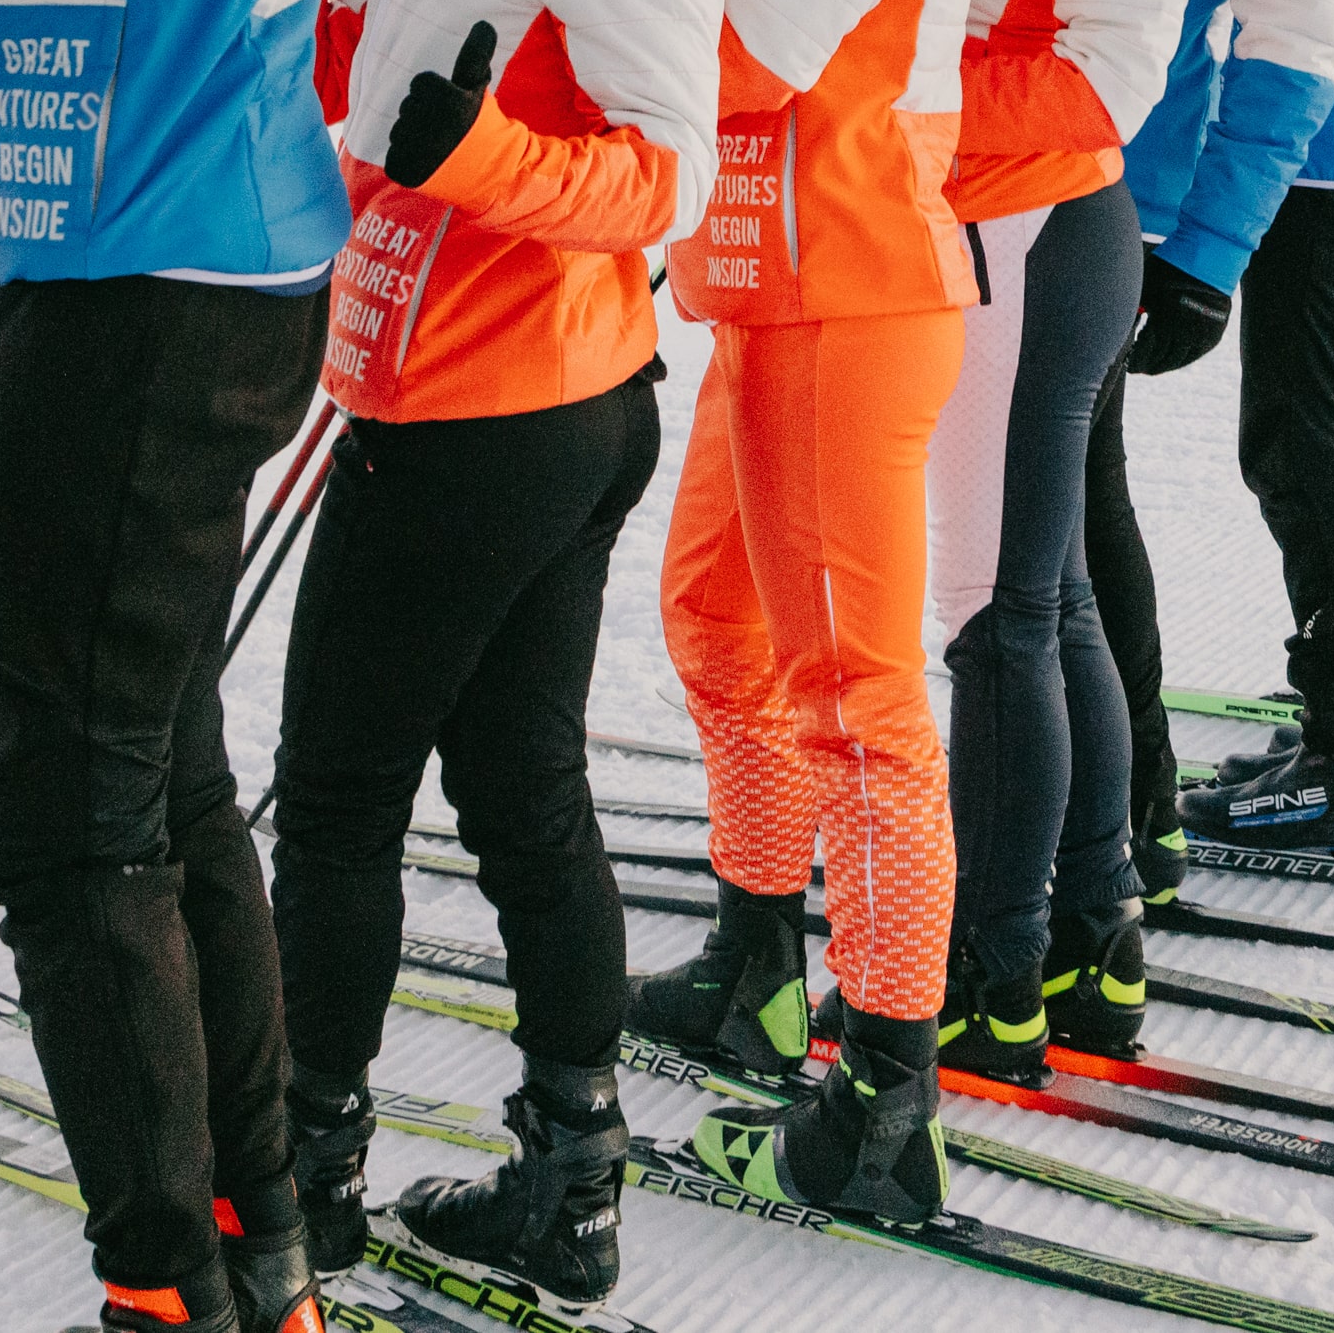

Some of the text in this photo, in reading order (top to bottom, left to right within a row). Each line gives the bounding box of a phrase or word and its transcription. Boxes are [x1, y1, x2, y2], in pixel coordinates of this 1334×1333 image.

[1, 37, 91, 78] GREAT
[354, 210, 420, 259] GREAT
[709, 216, 761, 247] BEGIN
[706, 256, 760, 289] INSIDE
[335, 290, 385, 341] BEGIN
[1225, 704, 1289, 718] PREMIO
[1228, 786, 1329, 817] SPINE
[1188, 1114, 1321, 1156] NORDSETER
[635, 1170, 835, 1233] FISCHER
